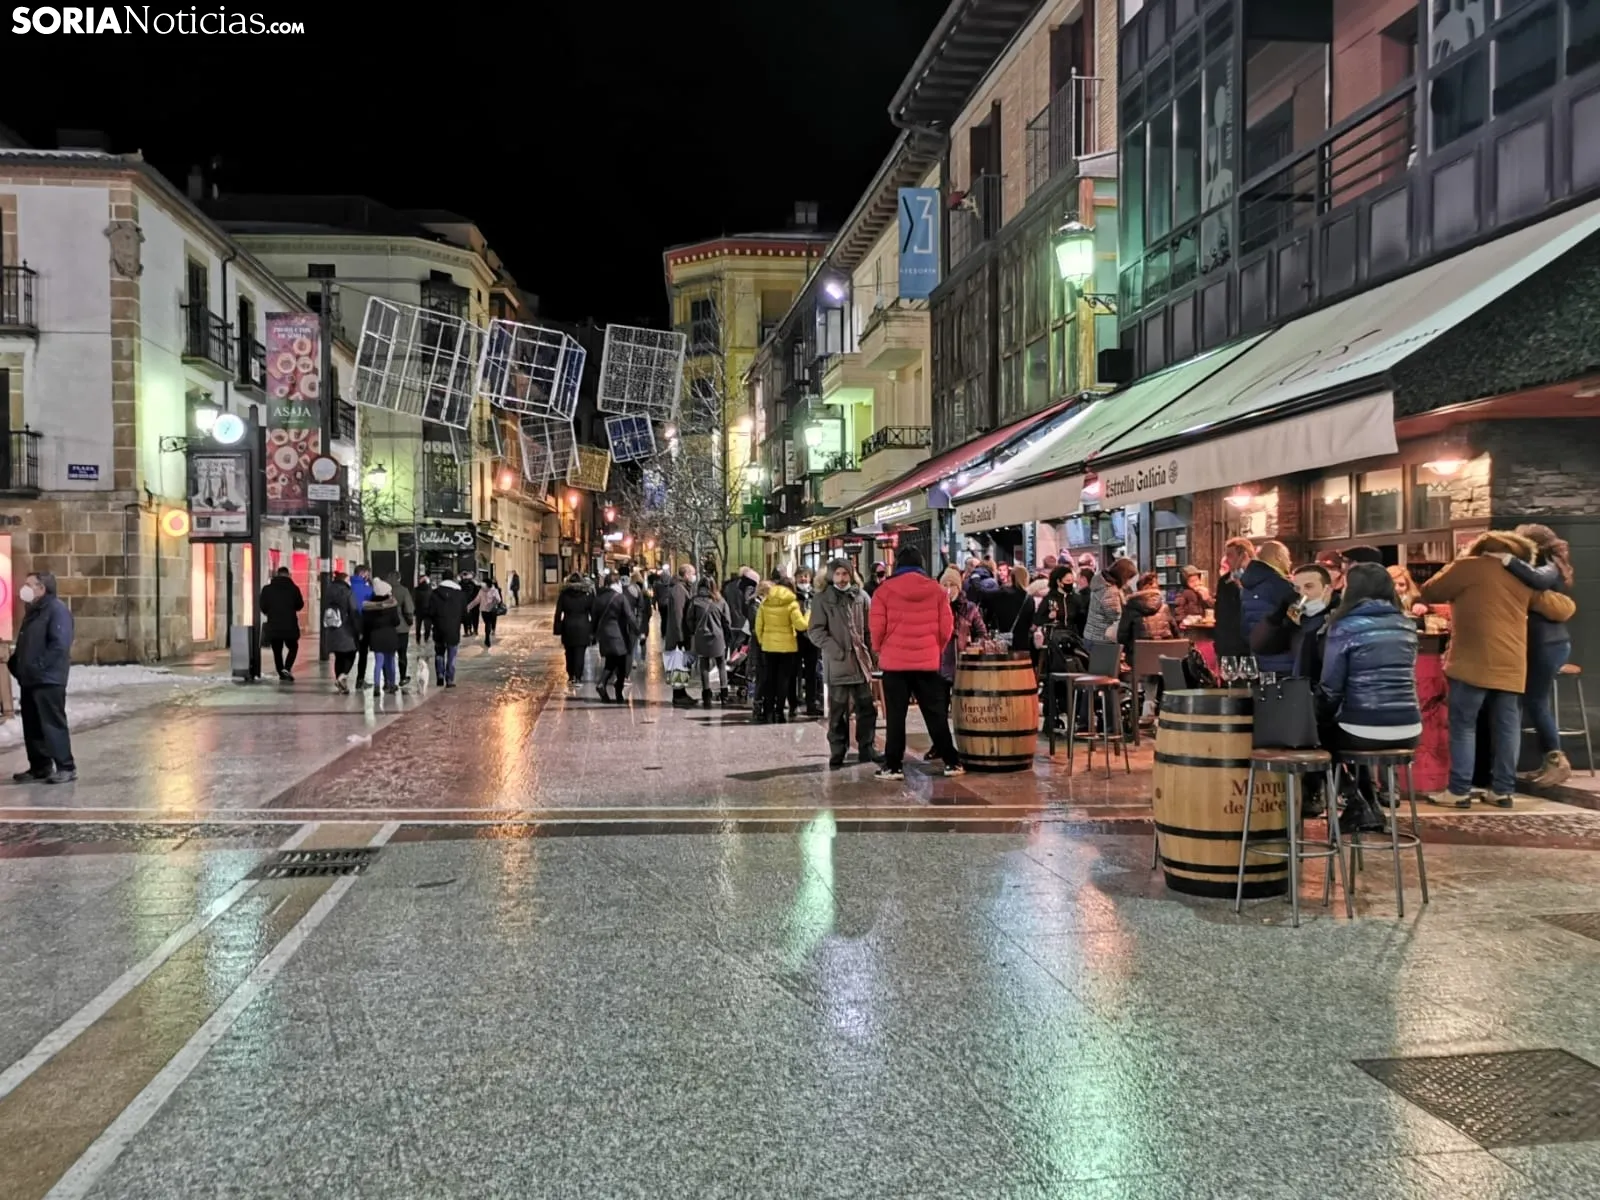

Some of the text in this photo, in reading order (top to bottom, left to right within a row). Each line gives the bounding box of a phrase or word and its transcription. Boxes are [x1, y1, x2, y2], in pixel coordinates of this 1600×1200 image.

[1105, 465, 1166, 498] Estrella Galicia
[450, 531, 474, 545] 58
[1231, 778, 1287, 797] Marqu
[1223, 799, 1244, 814] de
